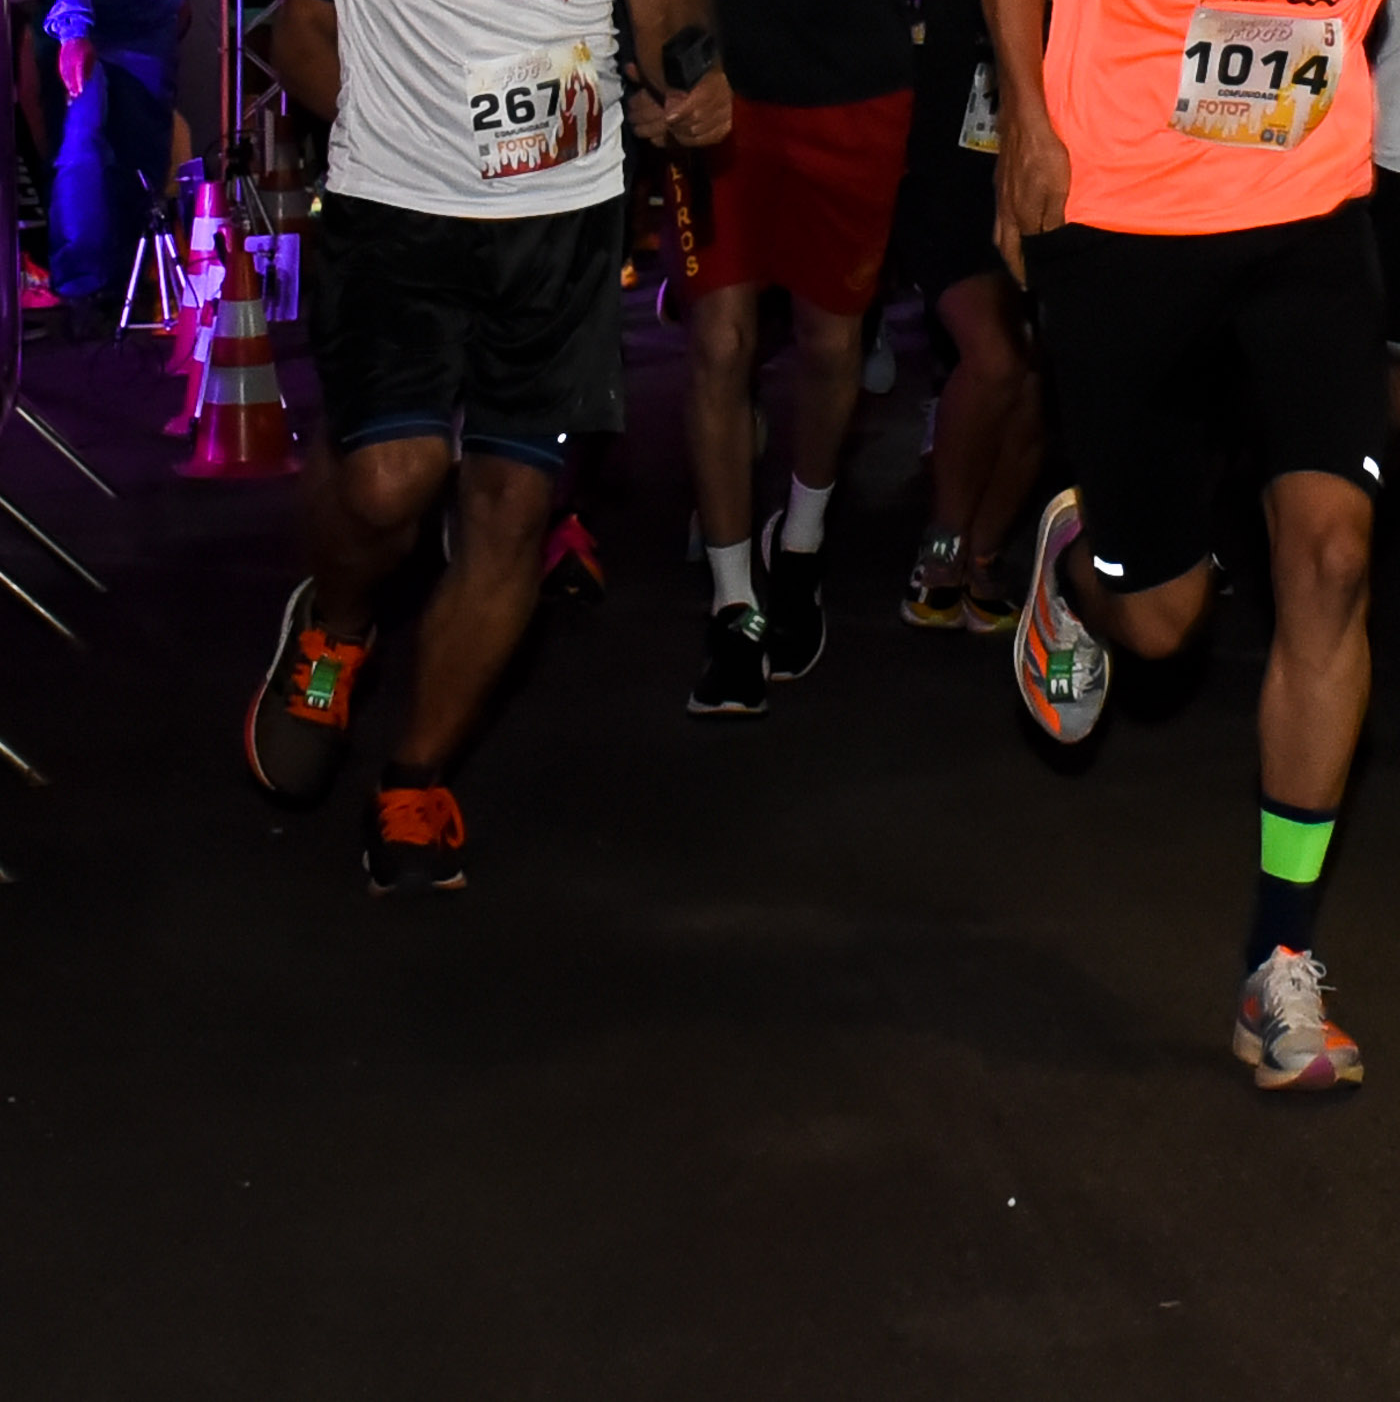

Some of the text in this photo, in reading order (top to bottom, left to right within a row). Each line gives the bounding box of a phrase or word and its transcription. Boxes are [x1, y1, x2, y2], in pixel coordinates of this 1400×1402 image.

[1324, 22, 1335, 47] 5
[1185, 41, 1329, 95] 1014
[470, 78, 561, 132] 267
